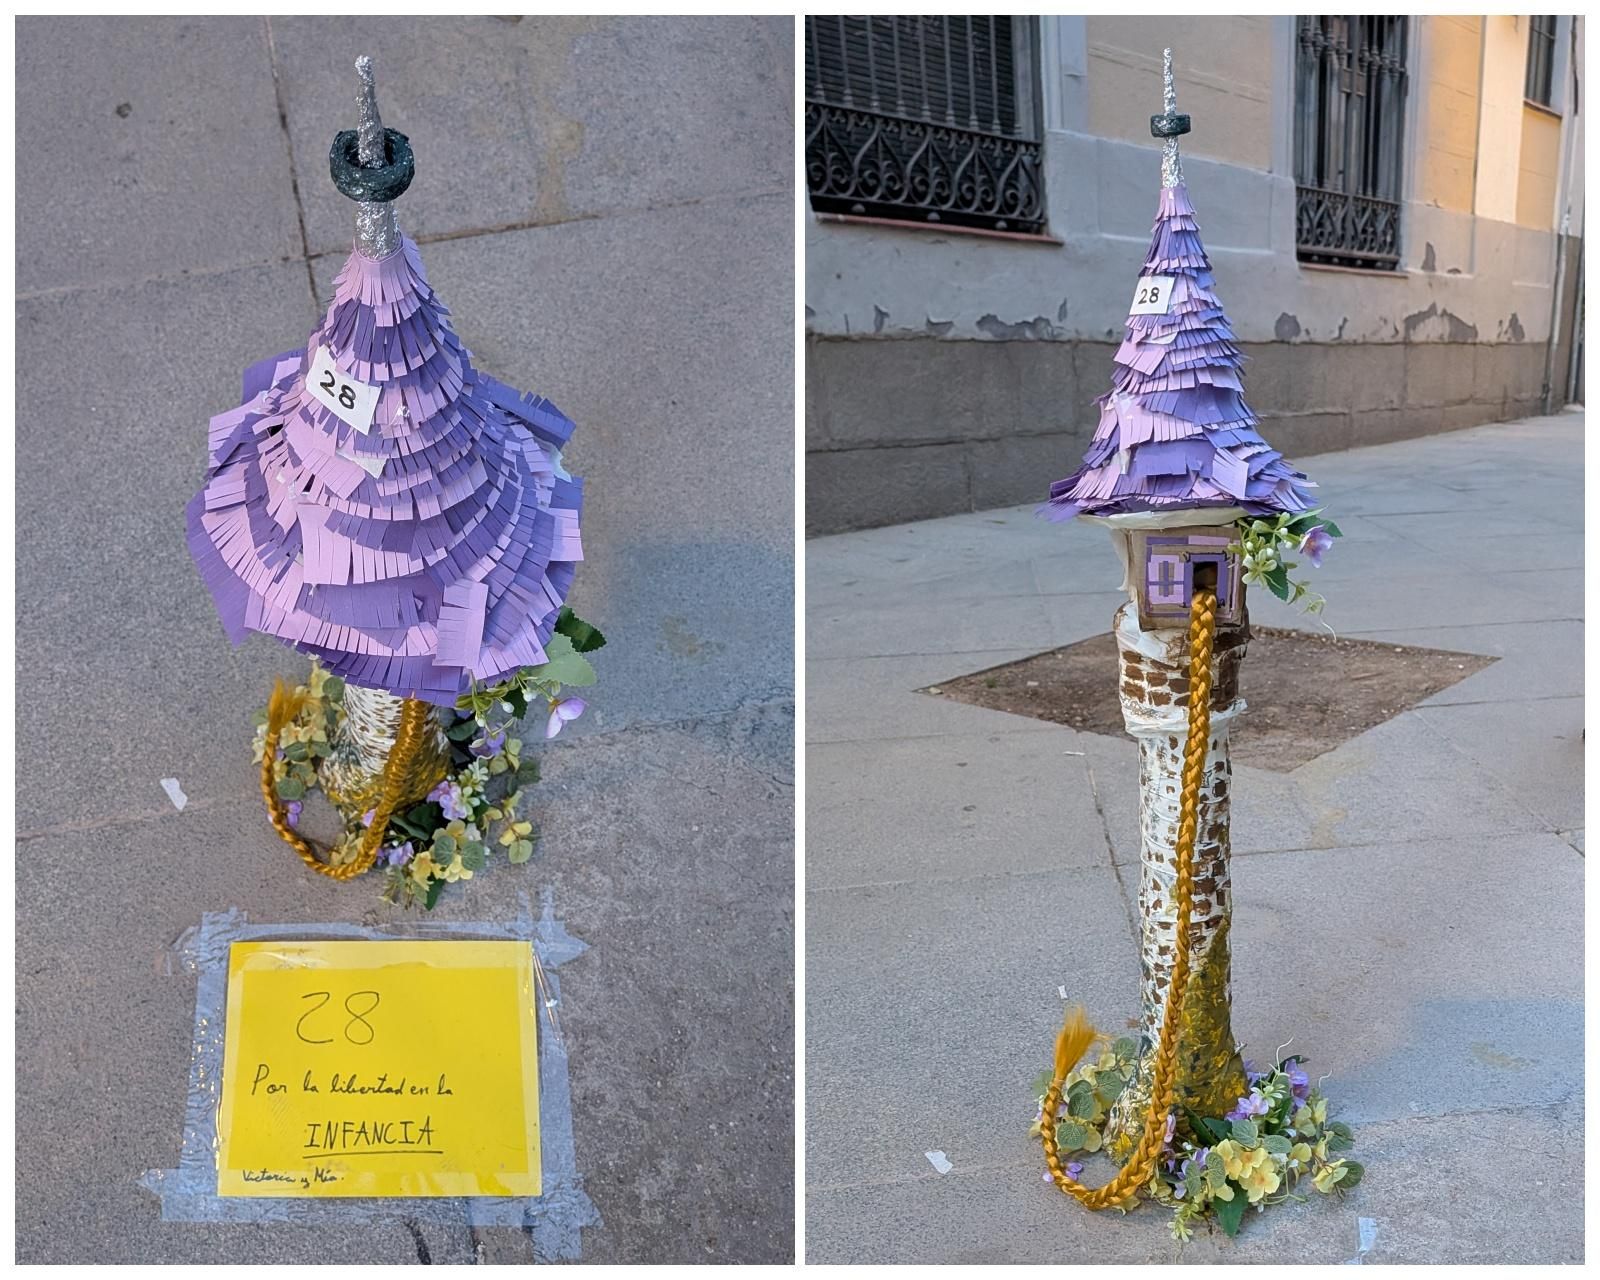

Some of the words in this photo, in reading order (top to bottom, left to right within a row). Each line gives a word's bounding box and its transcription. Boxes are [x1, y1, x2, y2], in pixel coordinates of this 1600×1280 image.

[1137, 286, 1160, 304] 28
[319, 369, 357, 410] 28
[296, 991, 379, 1045] 28
[251, 1063, 287, 1096] Por
[303, 1069, 319, 1093] la
[329, 1073, 405, 1095] libertad
[410, 1084, 428, 1096] en
[436, 1073, 453, 1096] la
[303, 1116, 434, 1150] INFANCIA
[242, 1167, 297, 1183] Victoria
[300, 1177, 311, 1189] y
